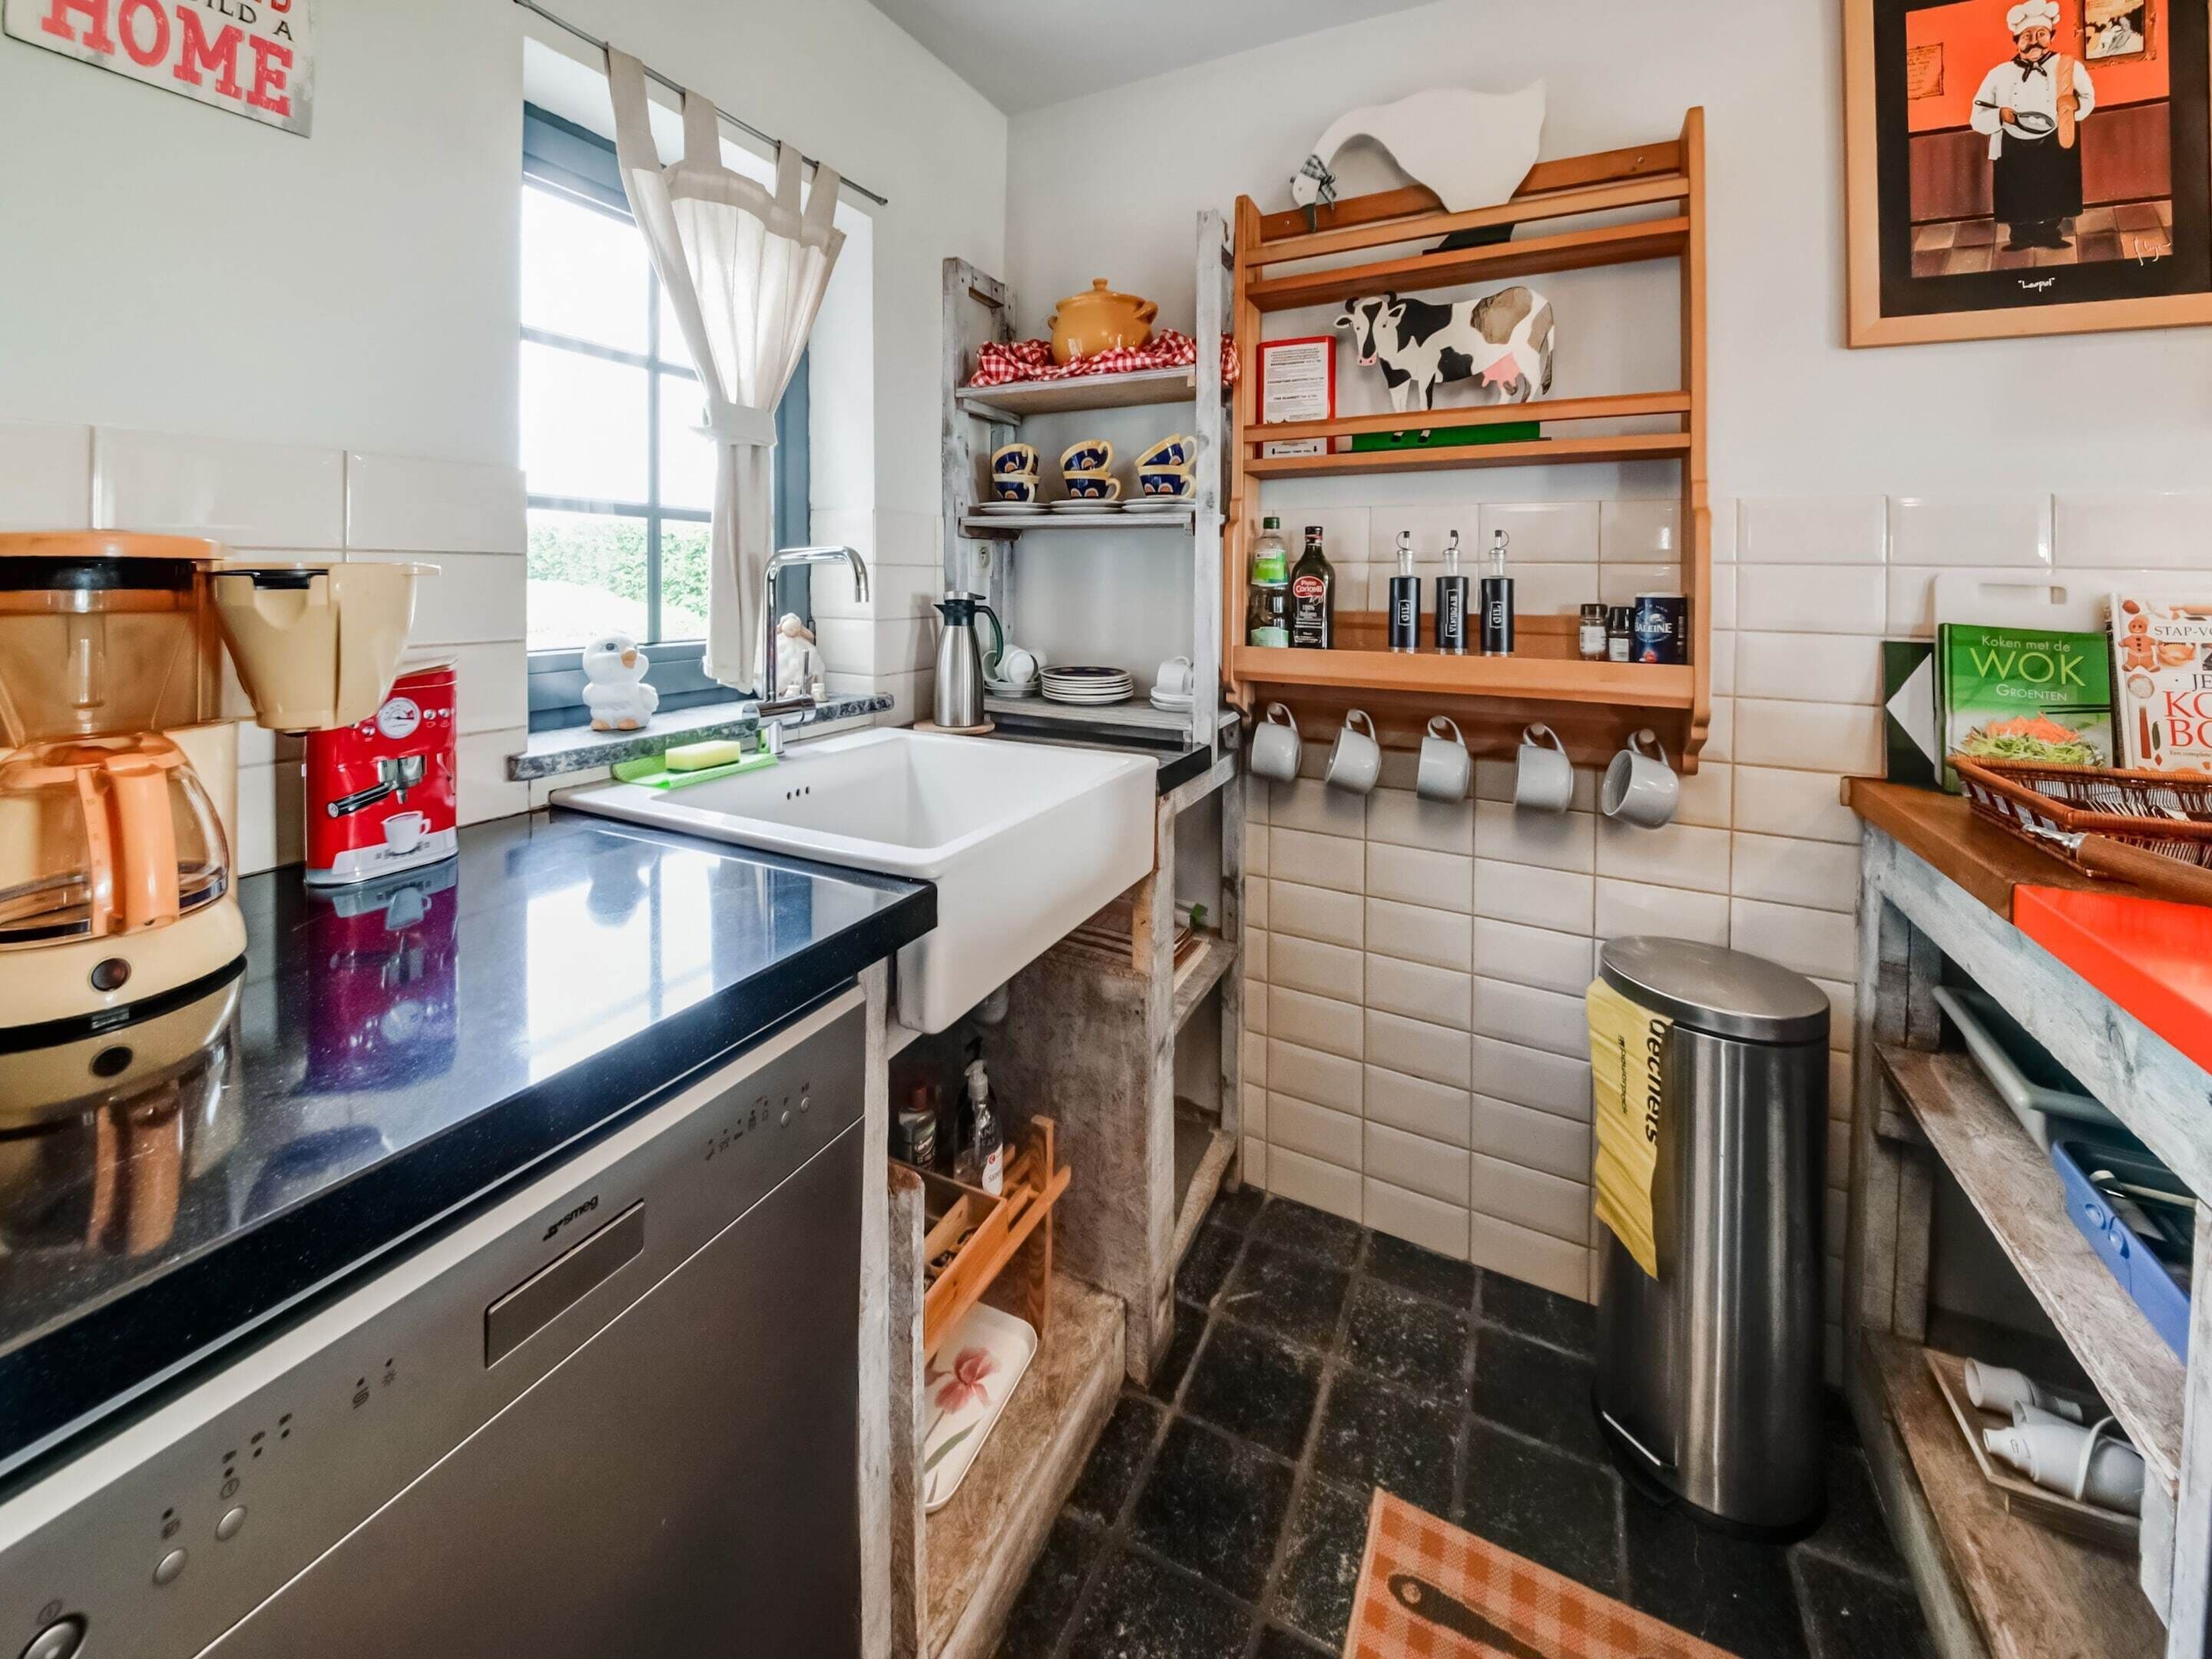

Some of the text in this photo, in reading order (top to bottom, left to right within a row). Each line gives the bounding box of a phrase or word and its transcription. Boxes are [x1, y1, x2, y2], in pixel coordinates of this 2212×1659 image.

[273, 21, 295, 42] A
[41, 0, 293, 118] HOME
[1400, 603, 1410, 621] OIL
[1492, 604, 1502, 624] OIL
[2154, 626, 2212, 637] STAP-V
[1982, 635, 2071, 652] Koken met de
[1969, 647, 2086, 687] WOK
[1995, 684, 2068, 700] GROENTEN
[563, 1194, 598, 1225] smeg
